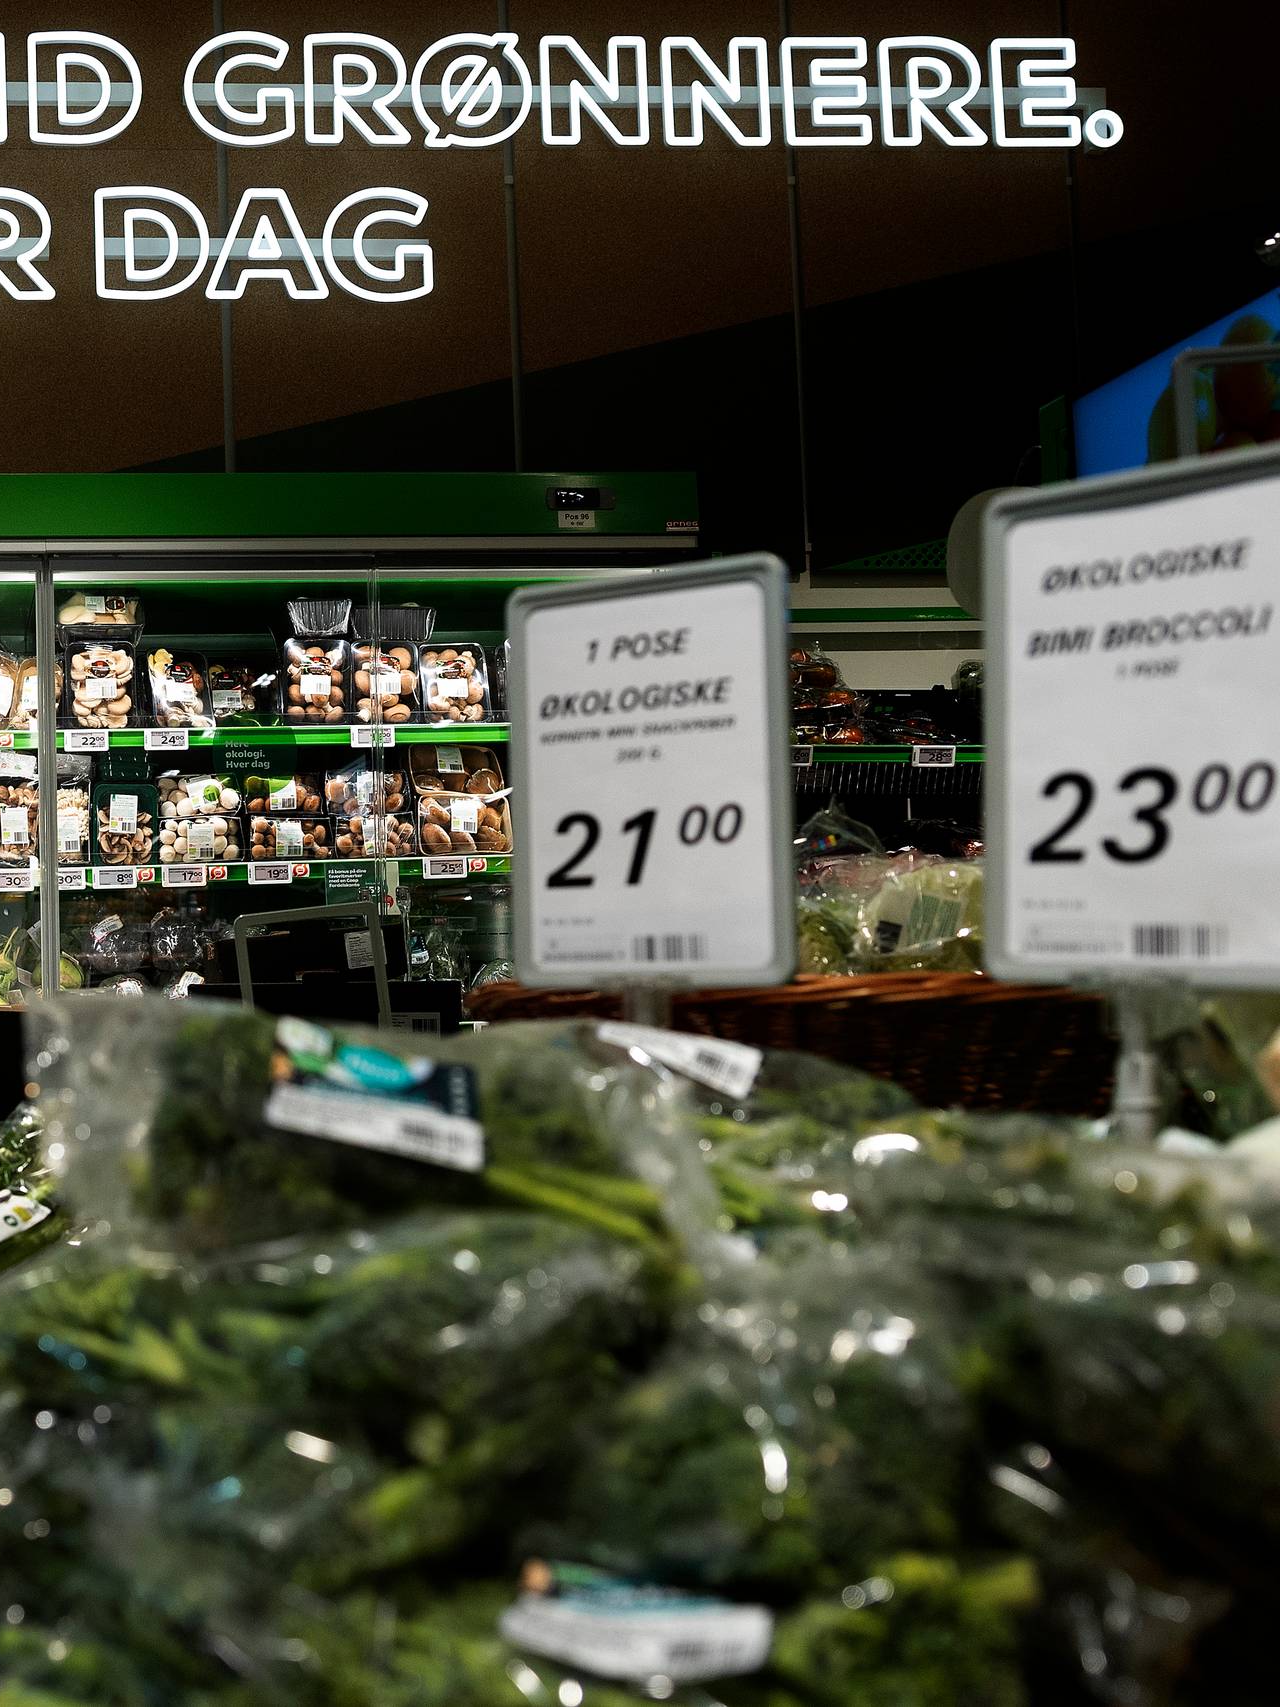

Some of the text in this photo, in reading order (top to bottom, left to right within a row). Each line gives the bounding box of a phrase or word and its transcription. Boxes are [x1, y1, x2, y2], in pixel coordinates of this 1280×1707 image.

[184, 31, 1124, 149] GRØNNERE.
[94, 186, 434, 303] DAG
[1041, 537, 1251, 595] ØKOLOGISKE
[585, 627, 690, 663] 1 POSE
[1027, 603, 1274, 659] BIMI BROCCOLI
[540, 677, 734, 721] ØKOLOGISKE
[251, 760, 270, 769] dag
